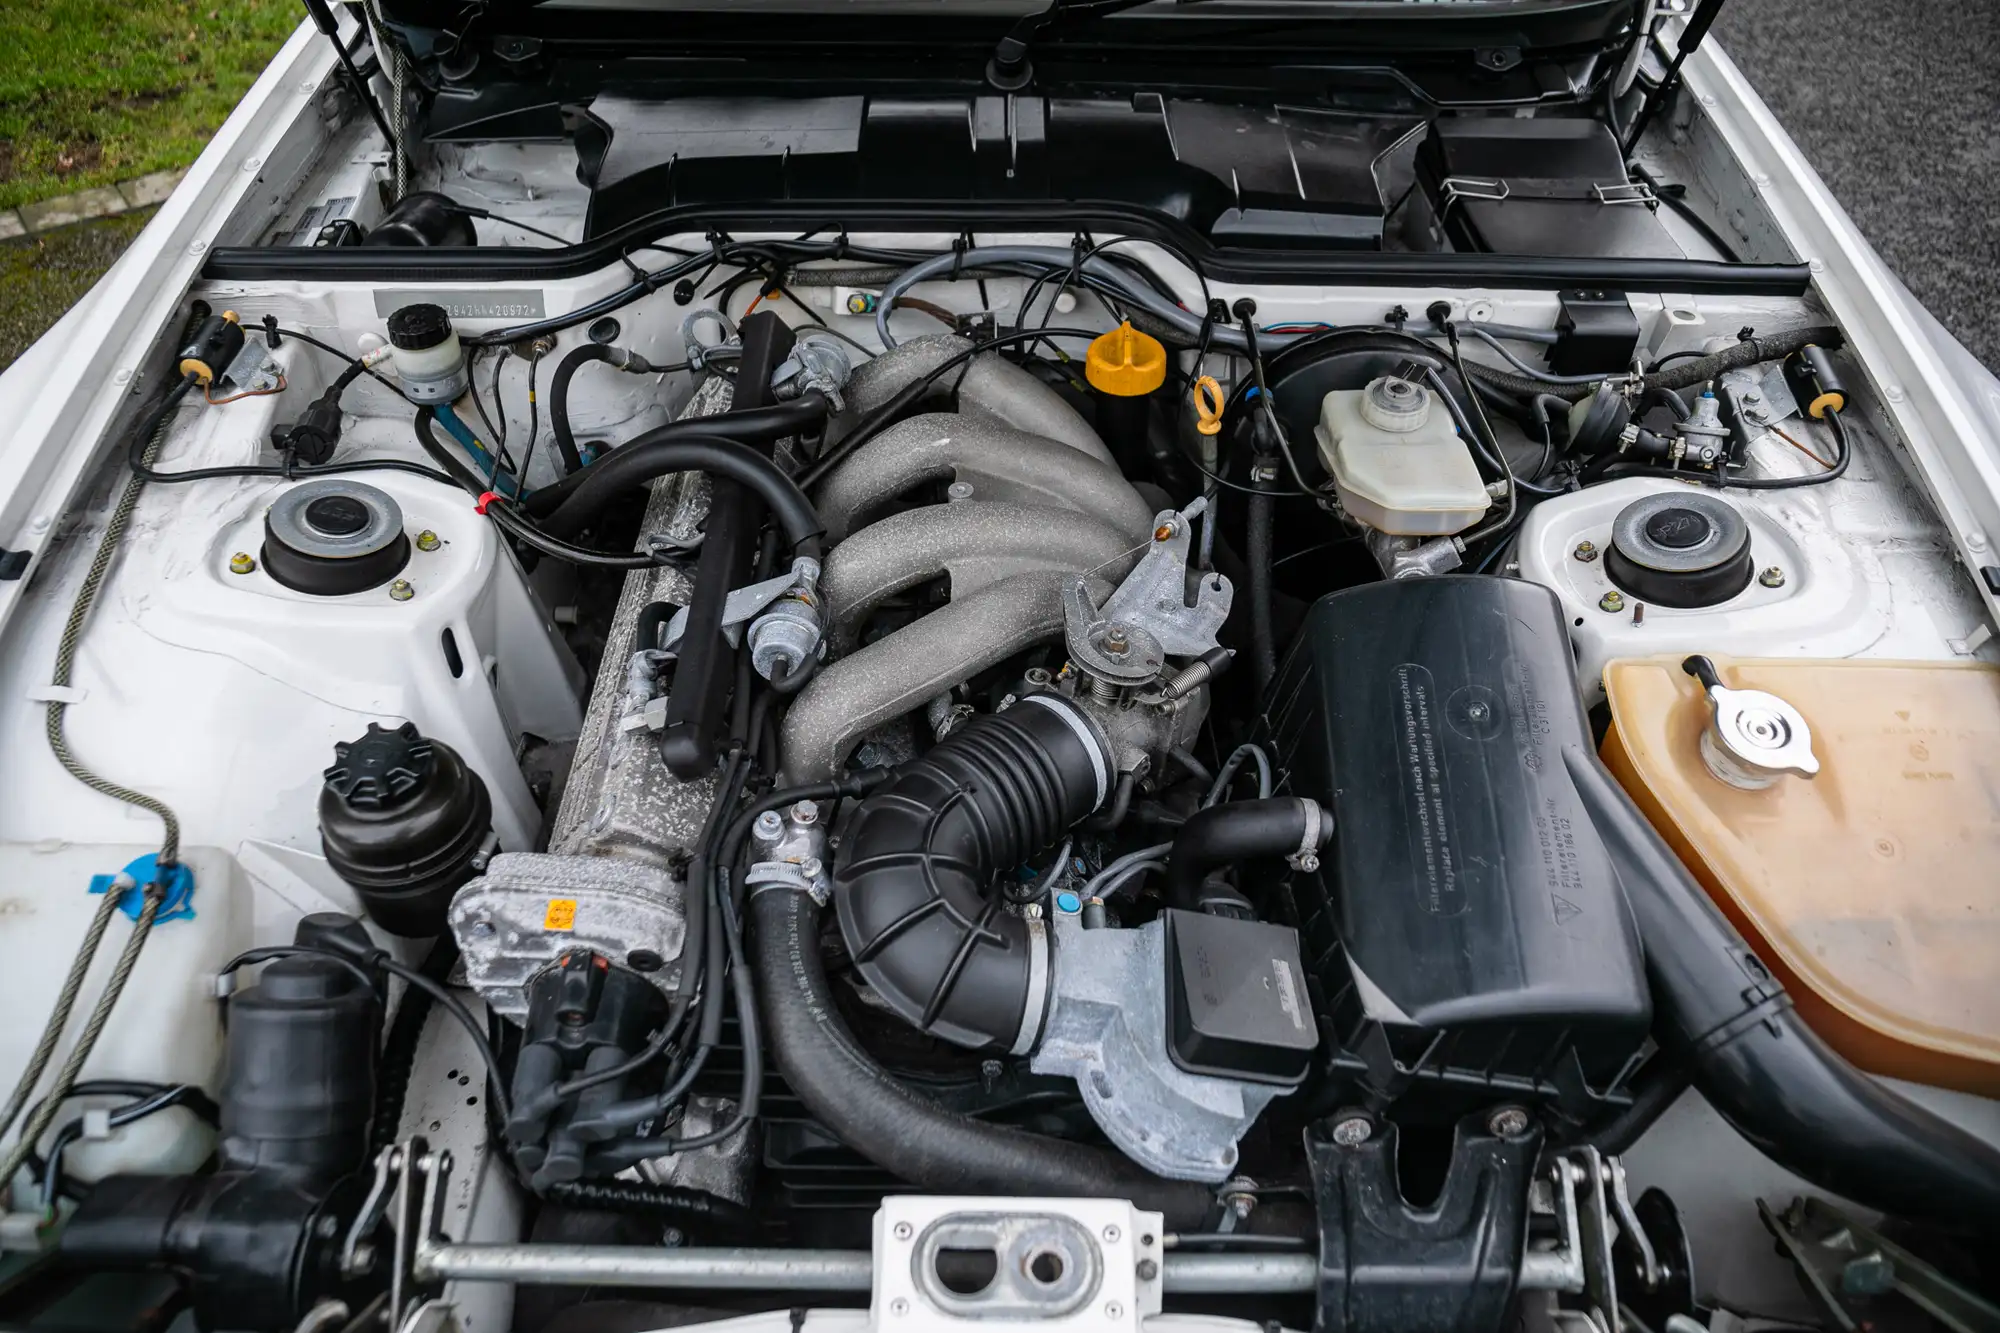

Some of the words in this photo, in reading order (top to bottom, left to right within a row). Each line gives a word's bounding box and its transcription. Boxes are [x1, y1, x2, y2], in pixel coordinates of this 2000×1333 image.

[1416, 685, 1430, 730] intervals
[1411, 765, 1423, 791] nach
[1433, 798, 1448, 841] element
[1440, 847, 1457, 892] Replace
